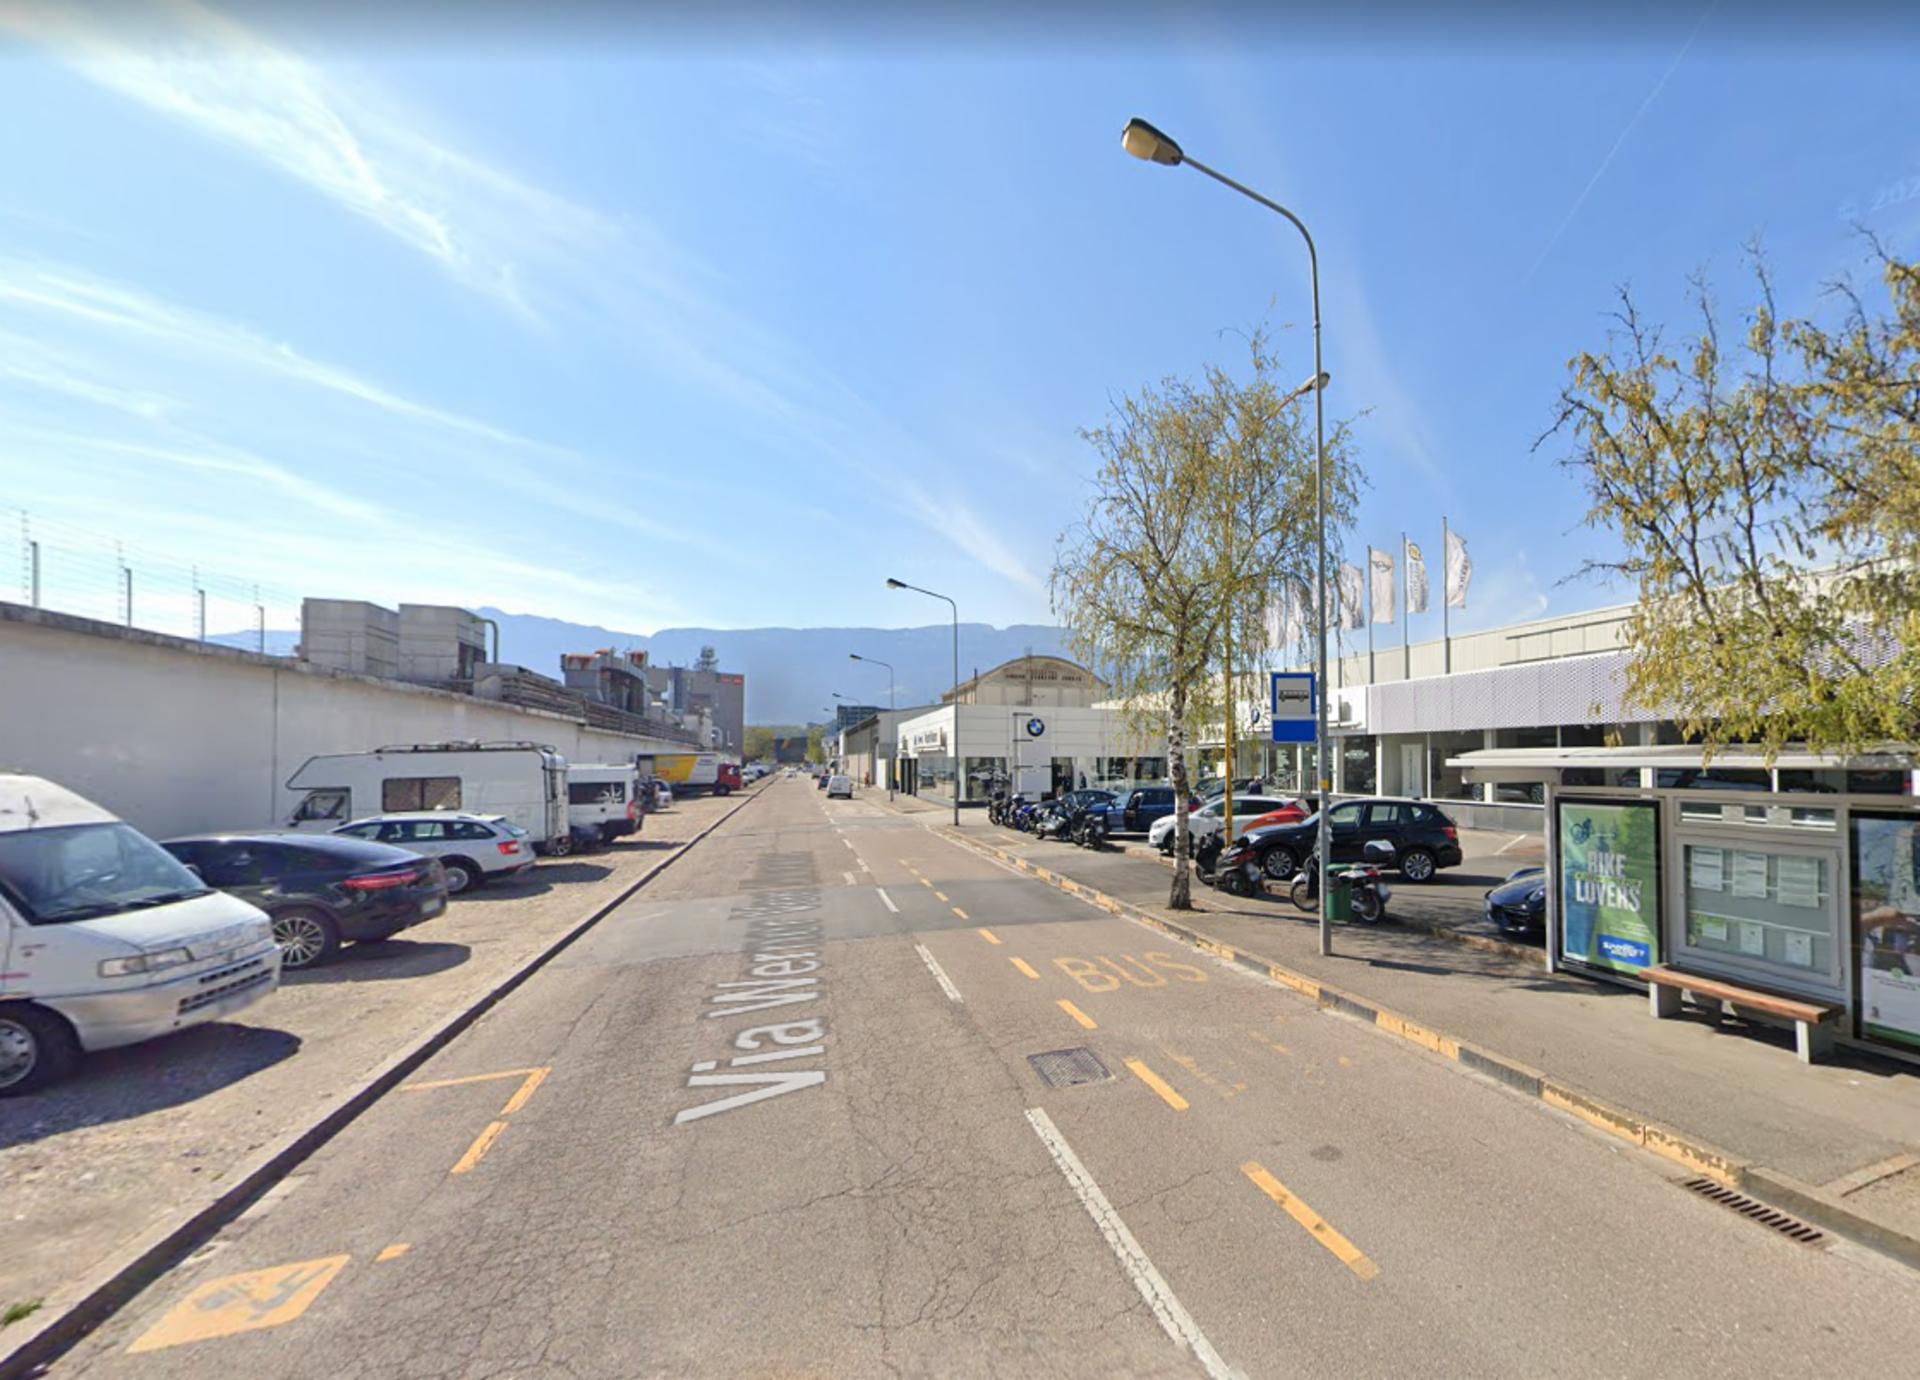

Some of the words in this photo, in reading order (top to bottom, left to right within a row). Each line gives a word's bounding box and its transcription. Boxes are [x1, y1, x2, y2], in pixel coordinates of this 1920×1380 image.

[1587, 851, 1627, 878] BIKE
[1575, 879, 1642, 913] LOVERS
[1052, 951, 1208, 992] BUS
